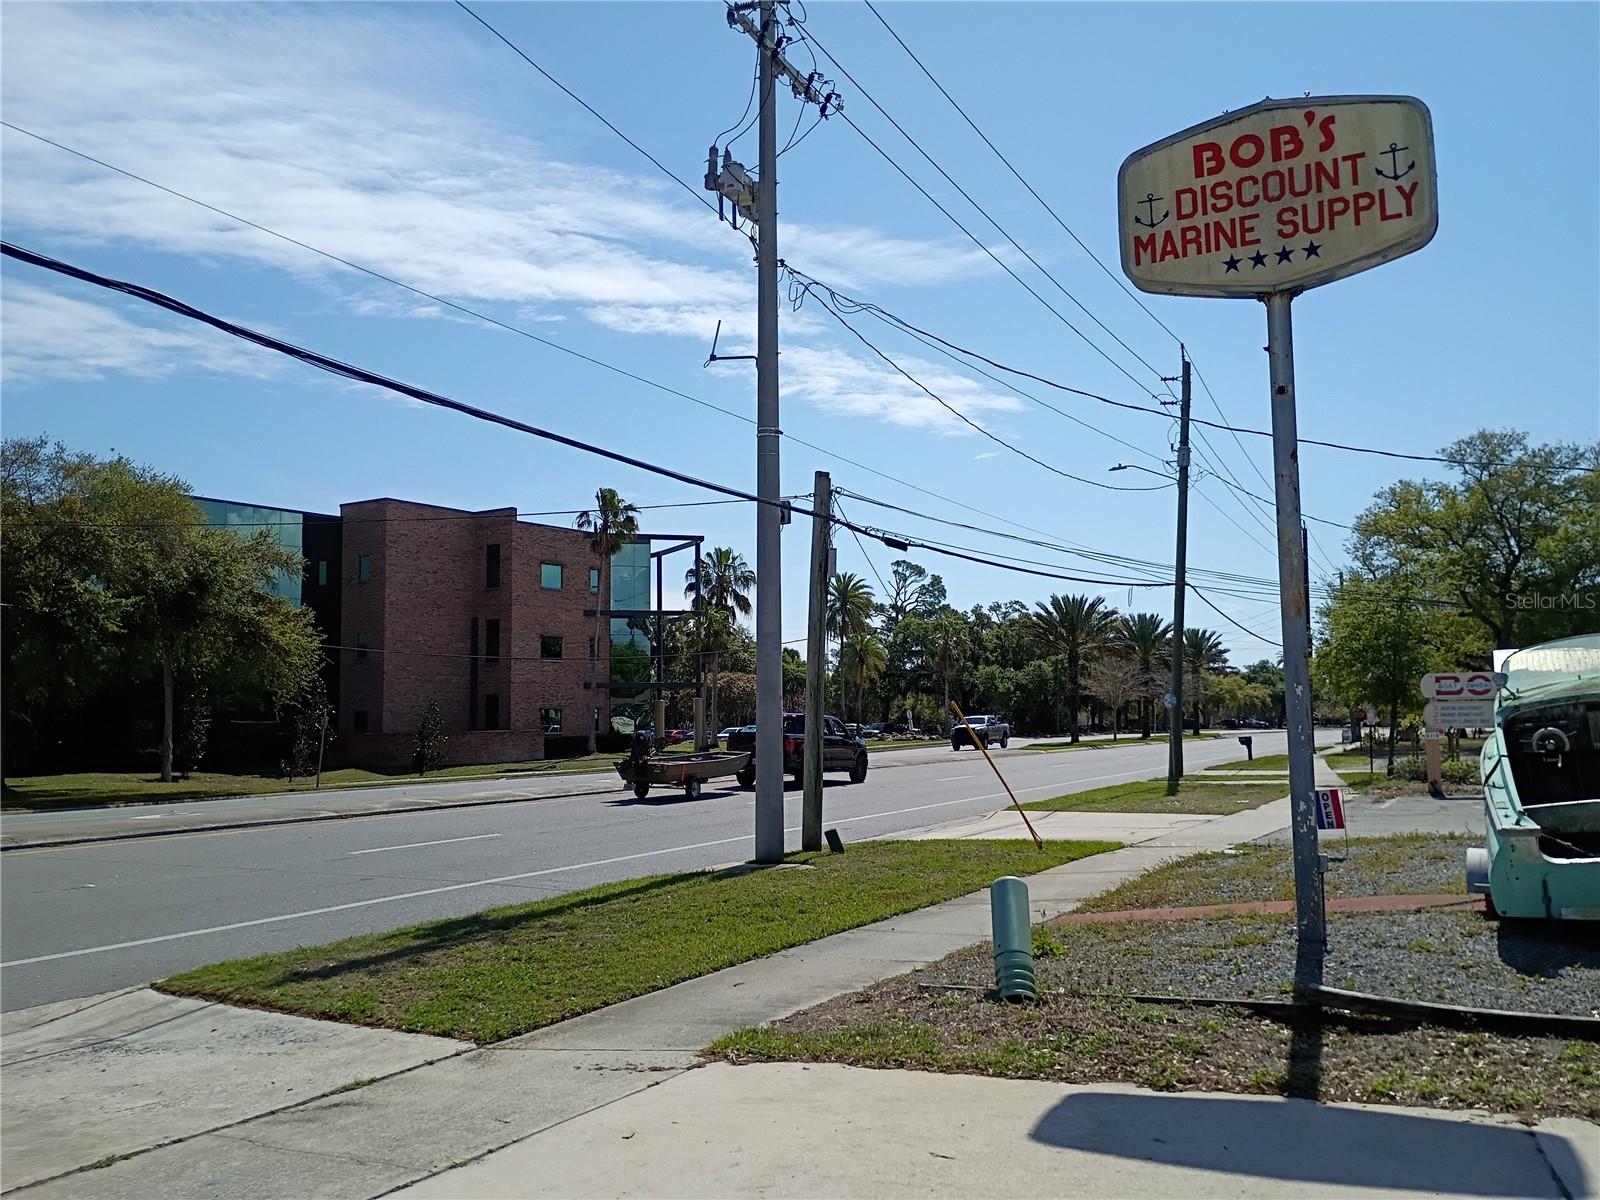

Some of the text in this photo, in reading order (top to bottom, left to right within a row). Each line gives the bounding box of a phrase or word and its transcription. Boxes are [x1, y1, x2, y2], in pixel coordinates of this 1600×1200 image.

[1192, 110, 1336, 179] BOB'S
[1175, 152, 1366, 221] DISCOUNT
[1133, 181, 1420, 267] MARINE SUPPLY
[1321, 792, 1335, 829] OPEN
